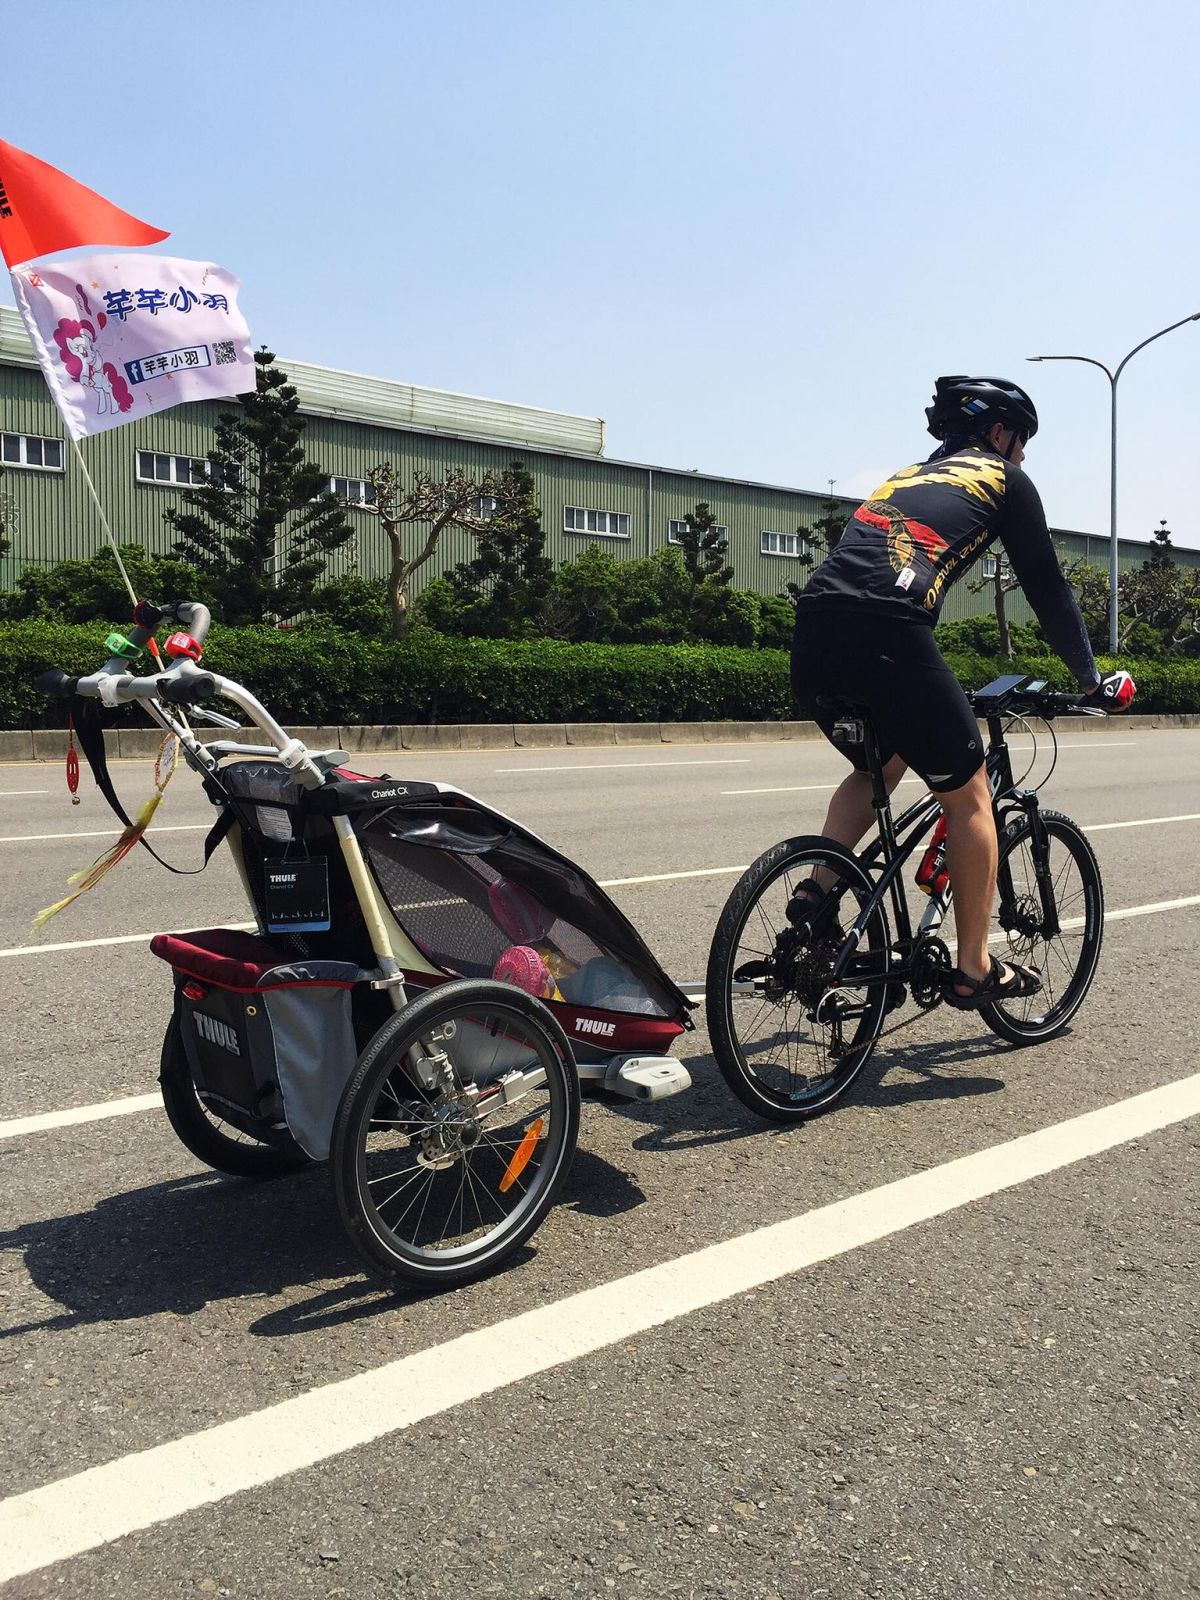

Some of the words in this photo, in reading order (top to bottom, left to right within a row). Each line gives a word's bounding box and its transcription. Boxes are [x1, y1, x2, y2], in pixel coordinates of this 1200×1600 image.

[103, 286, 230, 321] 芊芊小羽
[143, 350, 199, 375] 芊芊小羽
[371, 788, 397, 799] Chariot
[397, 786, 409, 796] CX
[270, 874, 297, 883] THULE
[192, 1010, 241, 1056] THULE
[575, 1017, 617, 1037] THULE
